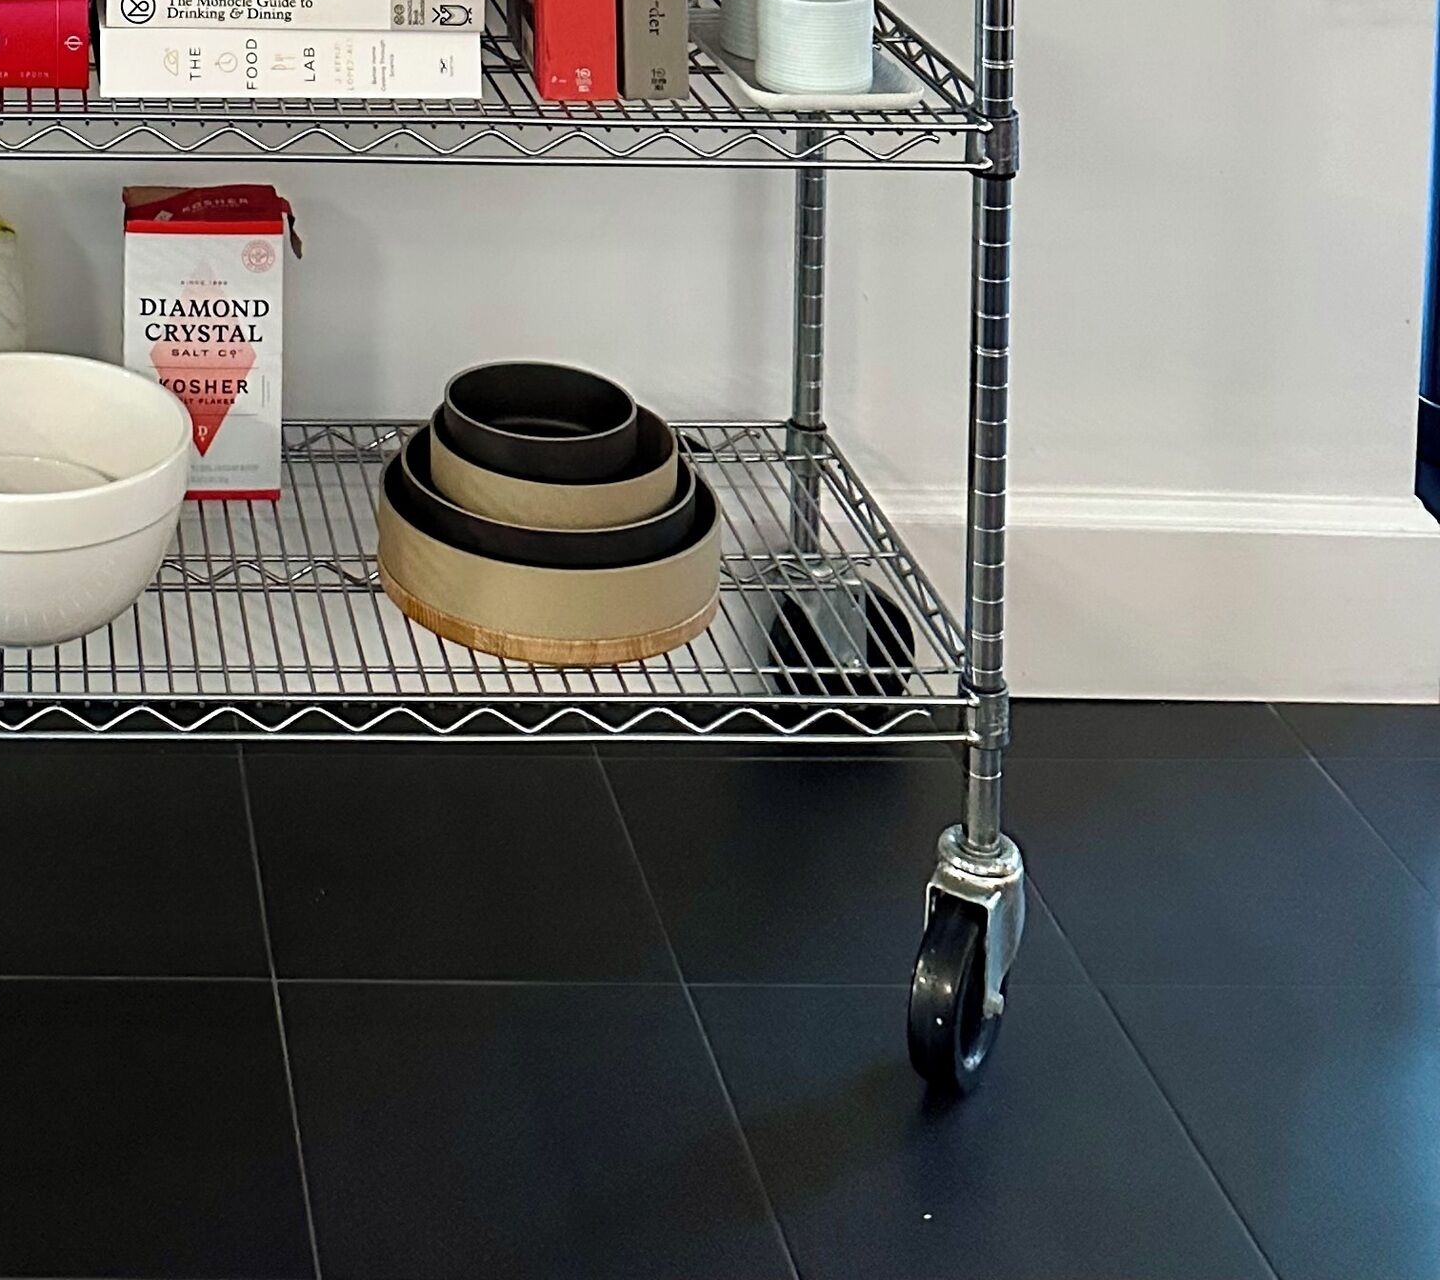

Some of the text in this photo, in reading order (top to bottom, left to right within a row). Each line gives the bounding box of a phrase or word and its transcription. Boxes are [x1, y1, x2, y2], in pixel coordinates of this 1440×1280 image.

[166, 6, 292, 23] Drinking & Dining
[189, 38, 316, 90] THE FOOD LAB
[140, 297, 270, 318] DIAMOND
[145, 323, 263, 343] CRYSTAL
[171, 348, 209, 357] SALT
[198, 425, 209, 437] D
